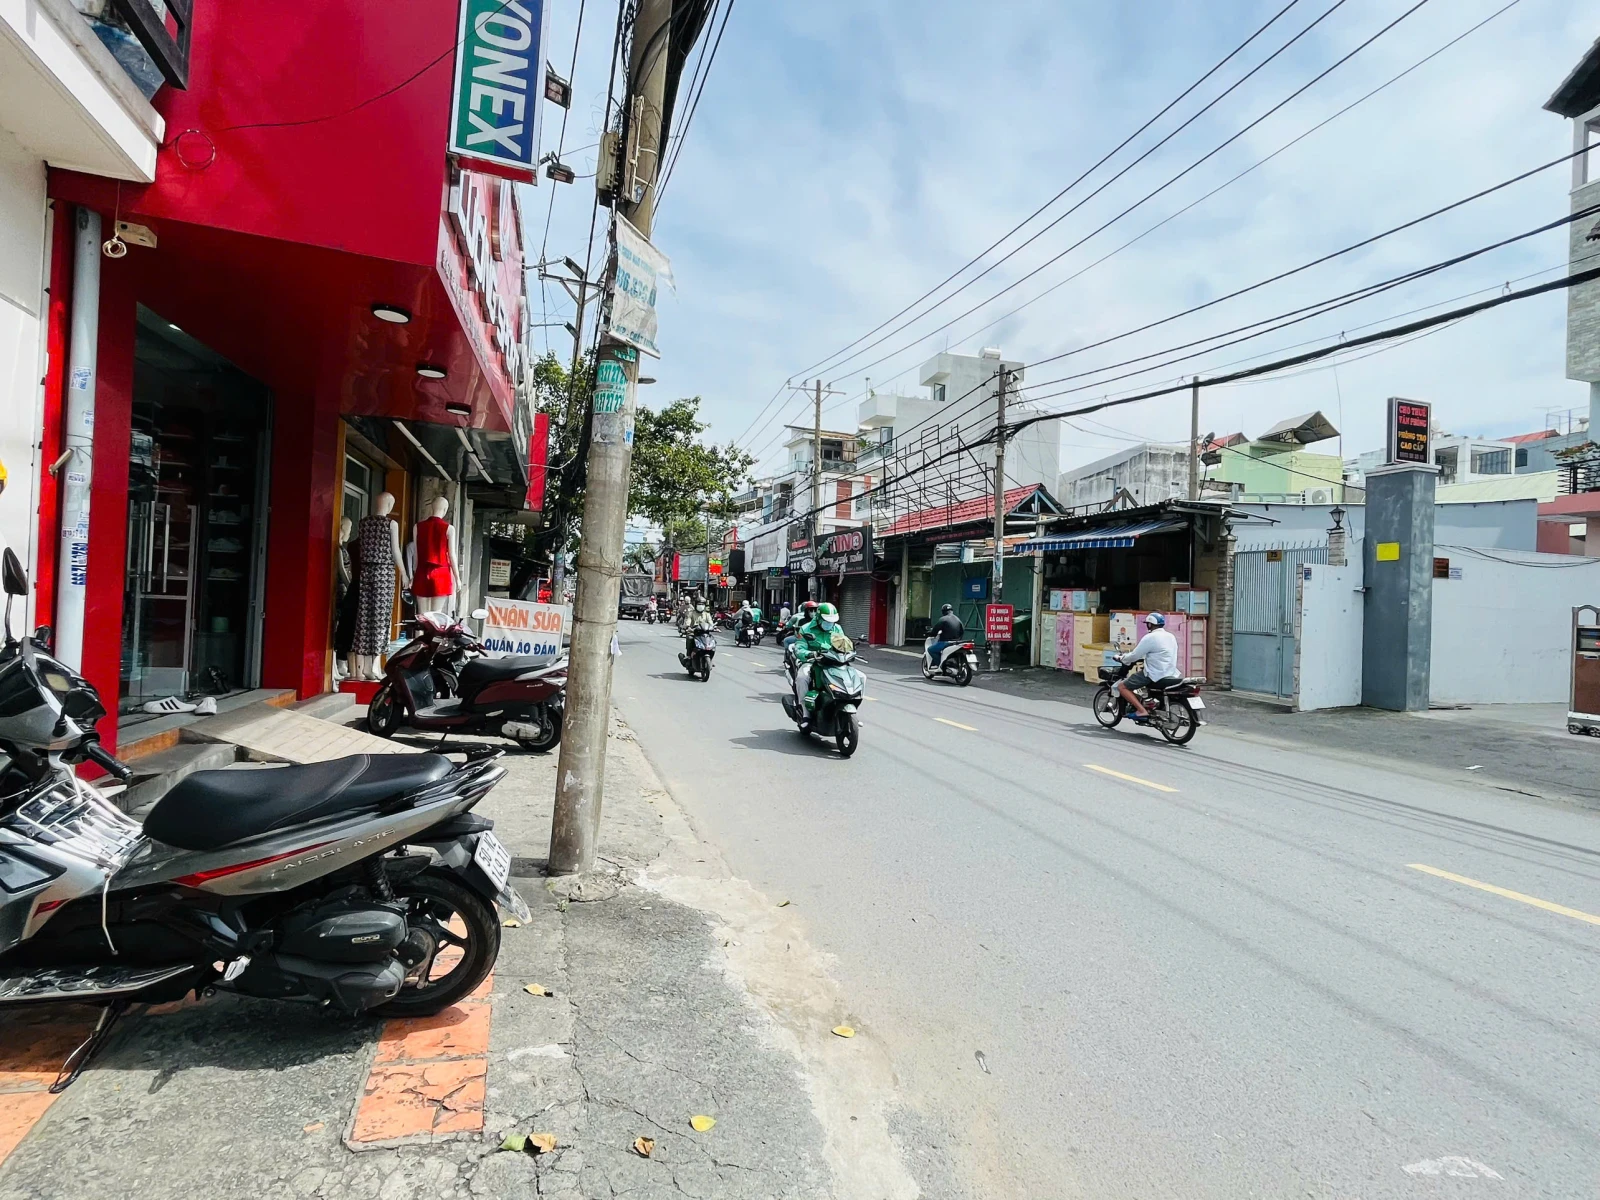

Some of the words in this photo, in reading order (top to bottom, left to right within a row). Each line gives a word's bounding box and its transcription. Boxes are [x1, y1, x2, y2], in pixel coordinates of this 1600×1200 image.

[1399, 405, 1411, 415] CHO
[533, 607, 561, 631] SỬA
[516, 639, 531, 654] ÁO
